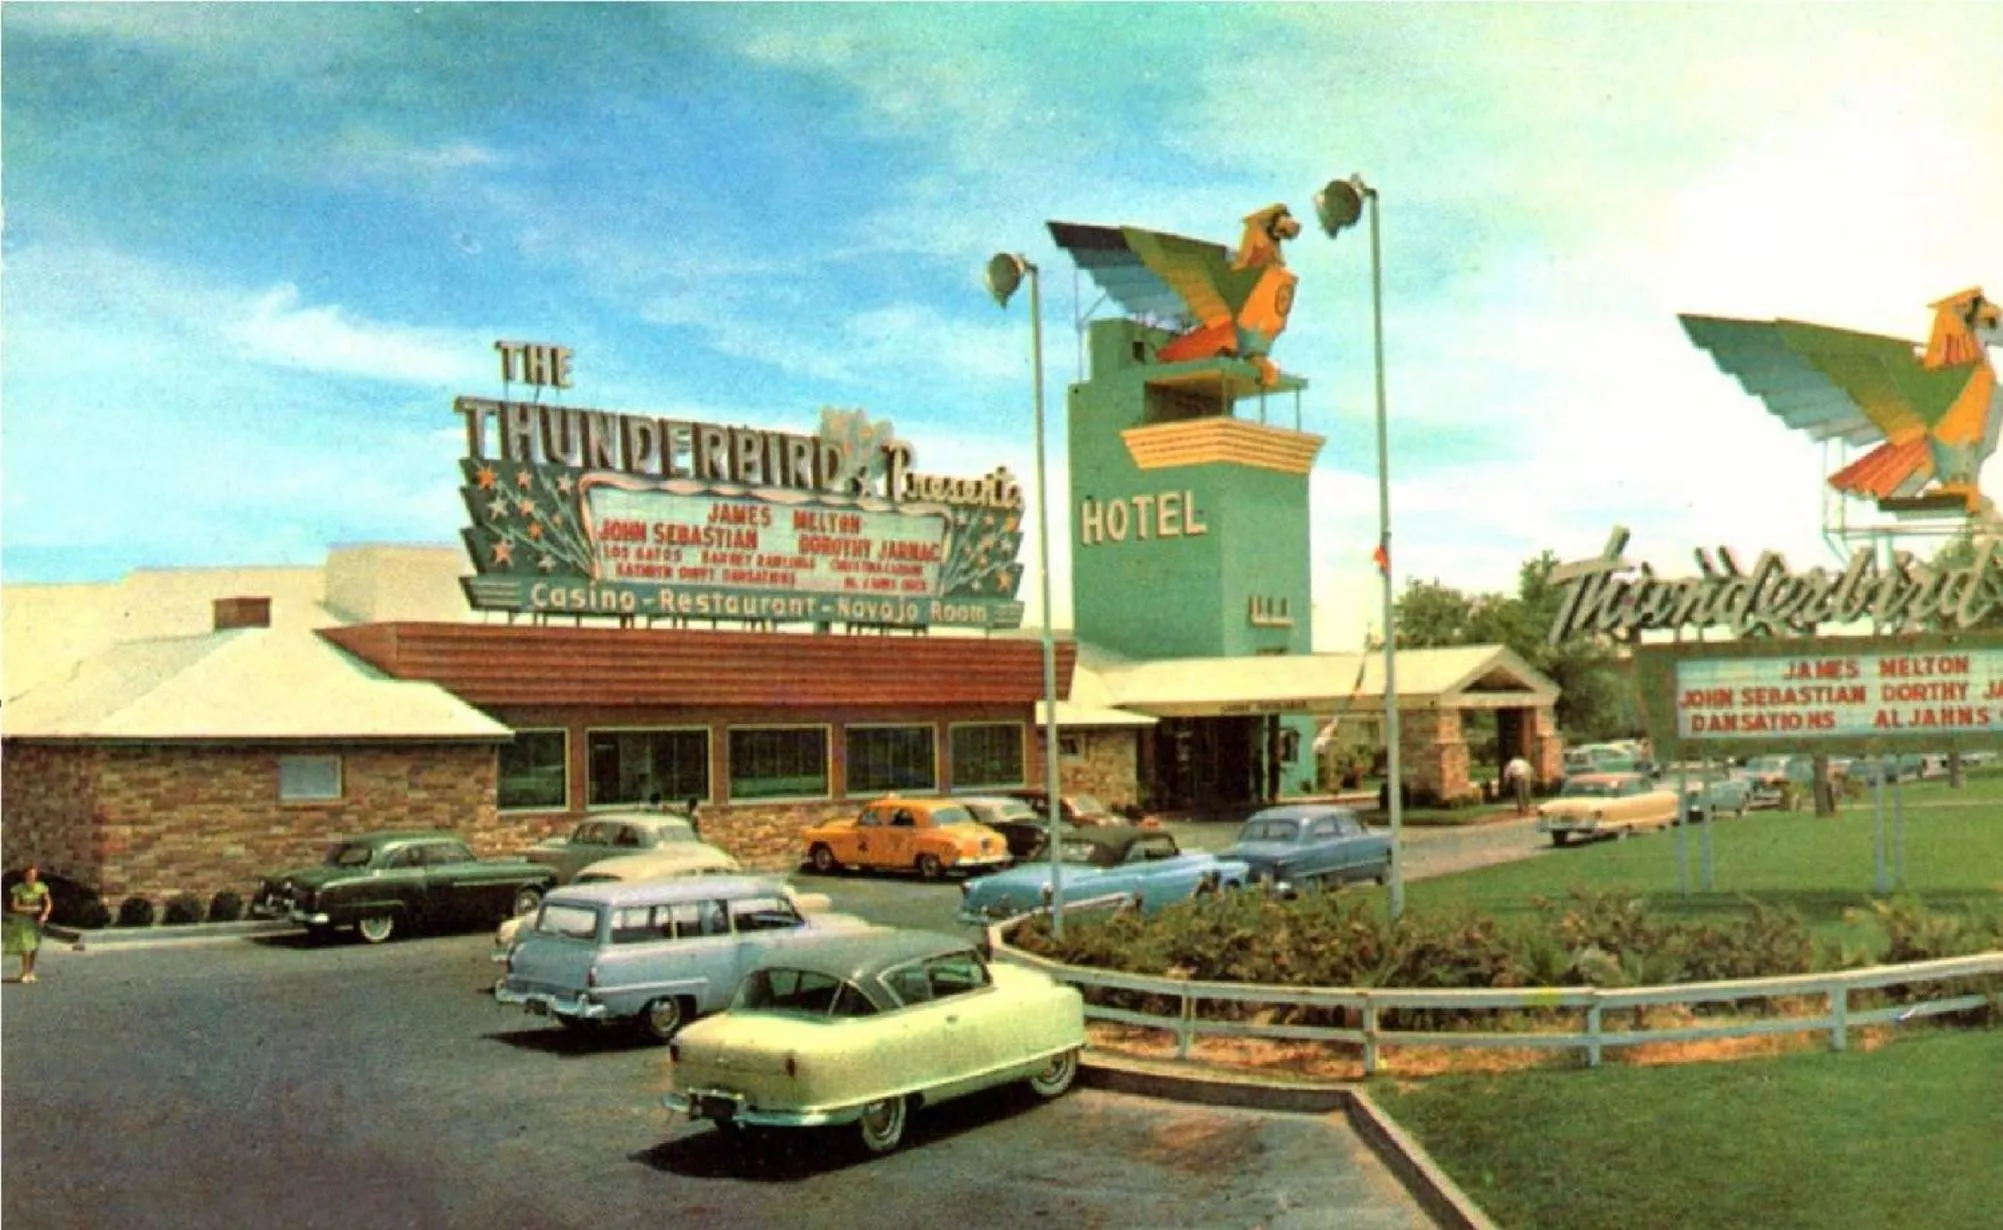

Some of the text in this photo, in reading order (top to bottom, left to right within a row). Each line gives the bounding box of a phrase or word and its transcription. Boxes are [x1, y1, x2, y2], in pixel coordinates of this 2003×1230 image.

[494, 341, 575, 388] THE
[453, 396, 846, 492] THUNDERBIRD
[708, 503, 772, 528] JAMES
[1081, 490, 1207, 544] HOTEL
[599, 519, 646, 541] JOHN
[653, 523, 758, 550] SEBASTIAN
[530, 582, 636, 614] Casino
[660, 588, 817, 623] Restaurant
[931, 601, 988, 622] Room
[1547, 525, 2000, 646] Thunderbird
[1783, 656, 1968, 680] JAMES MELTON
[1680, 688, 1733, 708] JOHN
[1741, 686, 1867, 706] SEBASTIAN
[1882, 681, 1968, 702] DORTHY
[1691, 711, 1836, 731] DANSATIONS
[1873, 708, 1902, 728] AL
